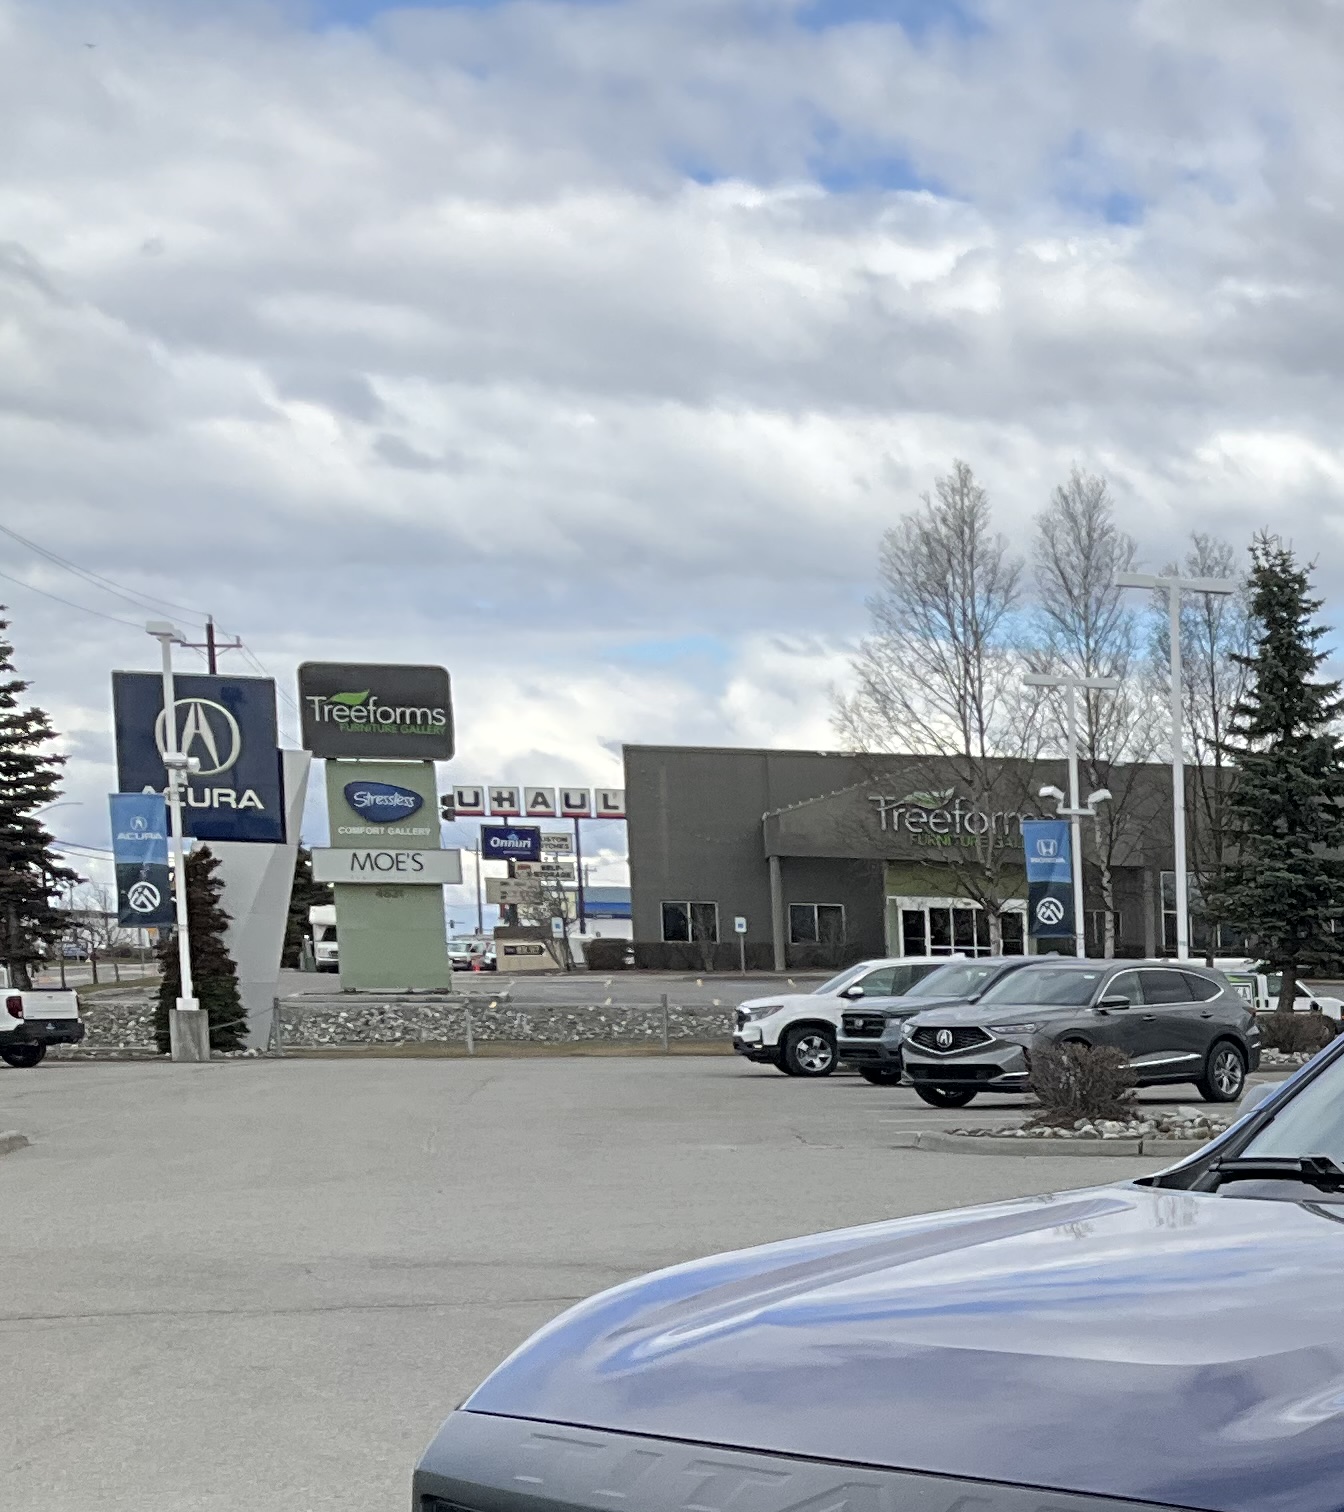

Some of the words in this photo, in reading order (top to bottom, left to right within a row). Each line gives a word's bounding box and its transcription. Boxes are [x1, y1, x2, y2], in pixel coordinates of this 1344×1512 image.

[305, 694, 447, 726] Treeforms
[339, 722, 398, 735] FURNITURE
[400, 724, 447, 736] GALLERY
[353, 791, 415, 808] Stressless
[868, 795, 1056, 836] Treeform
[116, 832, 163, 841] ACURA
[338, 826, 386, 835] COMFORT
[387, 827, 431, 836] GALLERY
[490, 836, 532, 849] Onnuri
[351, 852, 424, 872] MOE'S
